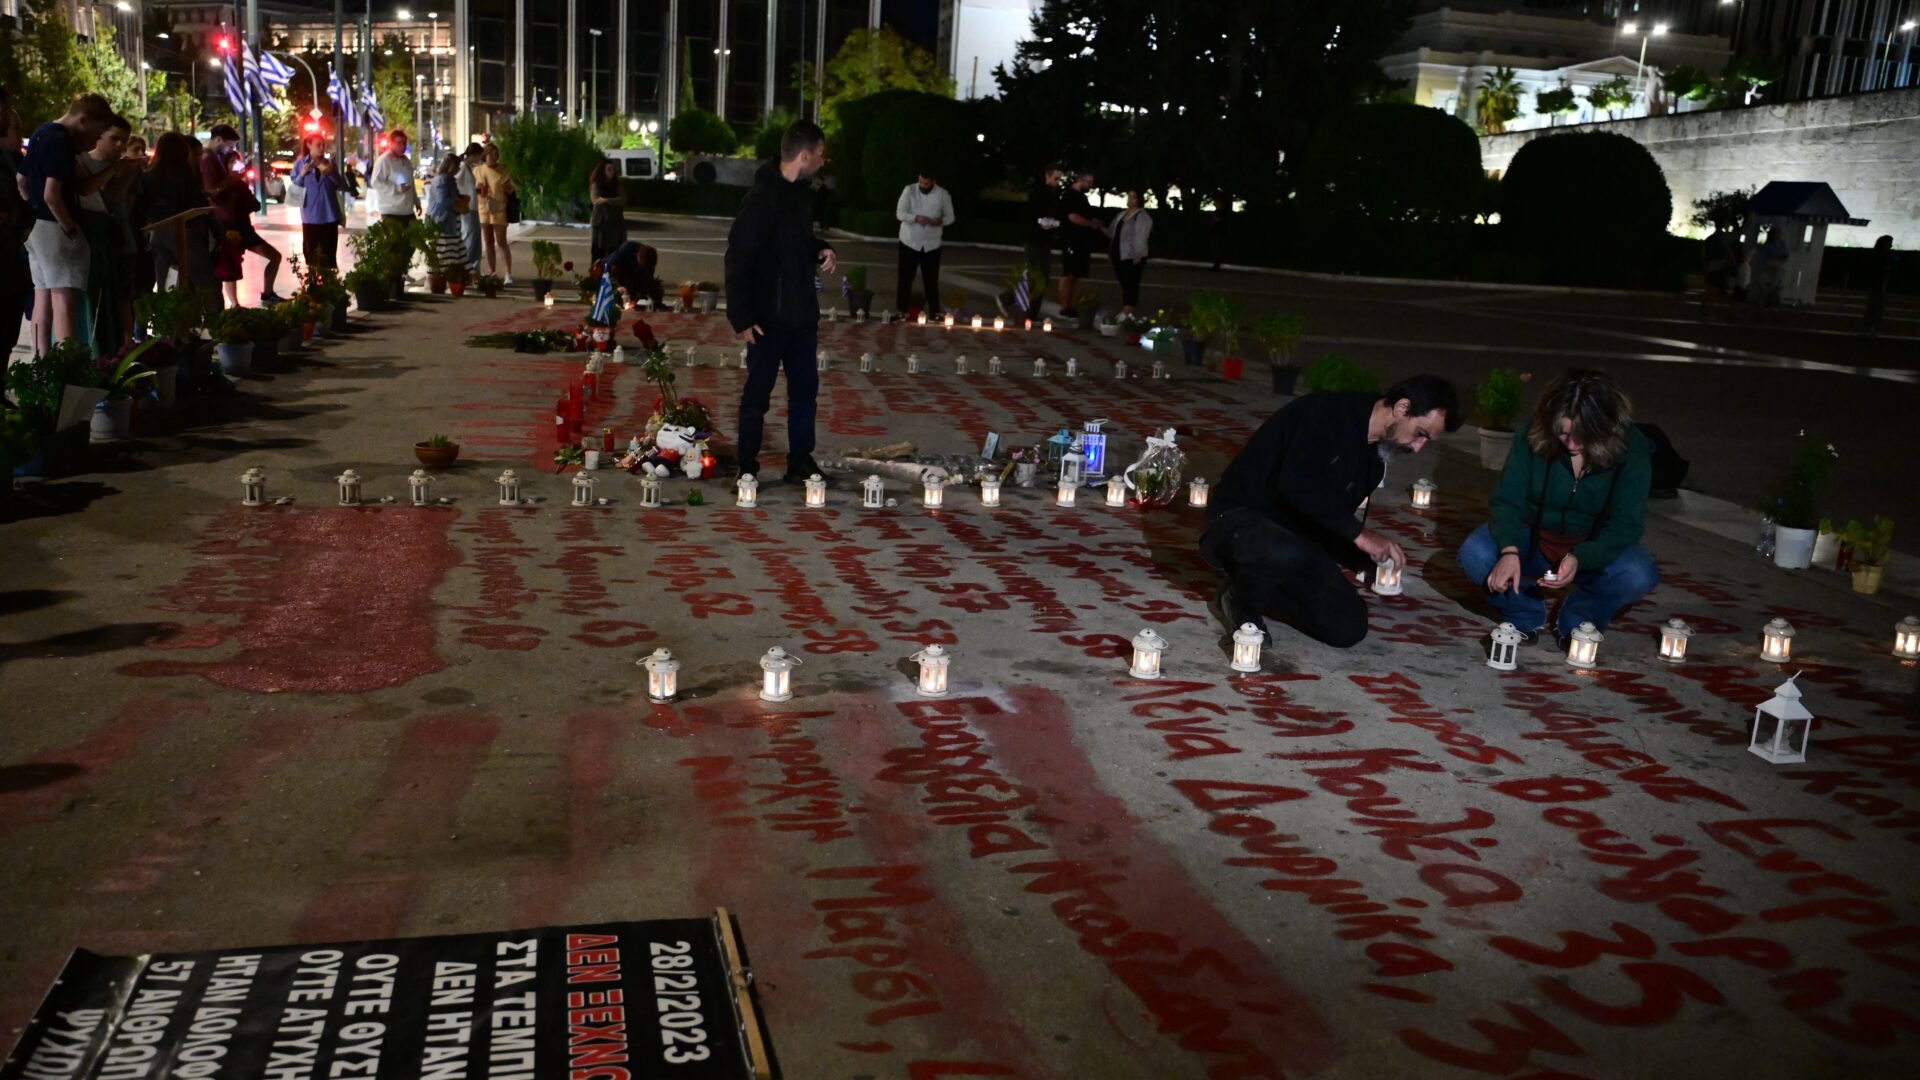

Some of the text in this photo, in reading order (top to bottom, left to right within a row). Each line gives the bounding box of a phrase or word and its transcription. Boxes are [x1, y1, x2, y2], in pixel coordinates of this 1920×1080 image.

[681, 592, 755, 619] 62
[883, 619, 958, 645] 57
[569, 620, 658, 648] 63
[803, 629, 880, 654] 58
[1349, 672, 1526, 764] Σπύρος
[1113, 680, 1247, 762] Λένα
[1398, 1000, 1590, 1080] 3
[149, 959, 197, 991] 57
[286, 949, 344, 1003] ΟΥΤΕ
[345, 953, 400, 1015] ΟΥΤΕ
[497, 938, 538, 987] ΣΤΑ
[565, 932, 619, 984] ΔΕΝ
[1488, 922, 1727, 1026] 35
[177, 954, 263, 1080] ΗΤΑΝ ΔΟΛΟΦ
[421, 961, 478, 1080] ΔΕΝ ΗΤΑΝ
[649, 940, 711, 1065] 28/2/2023
